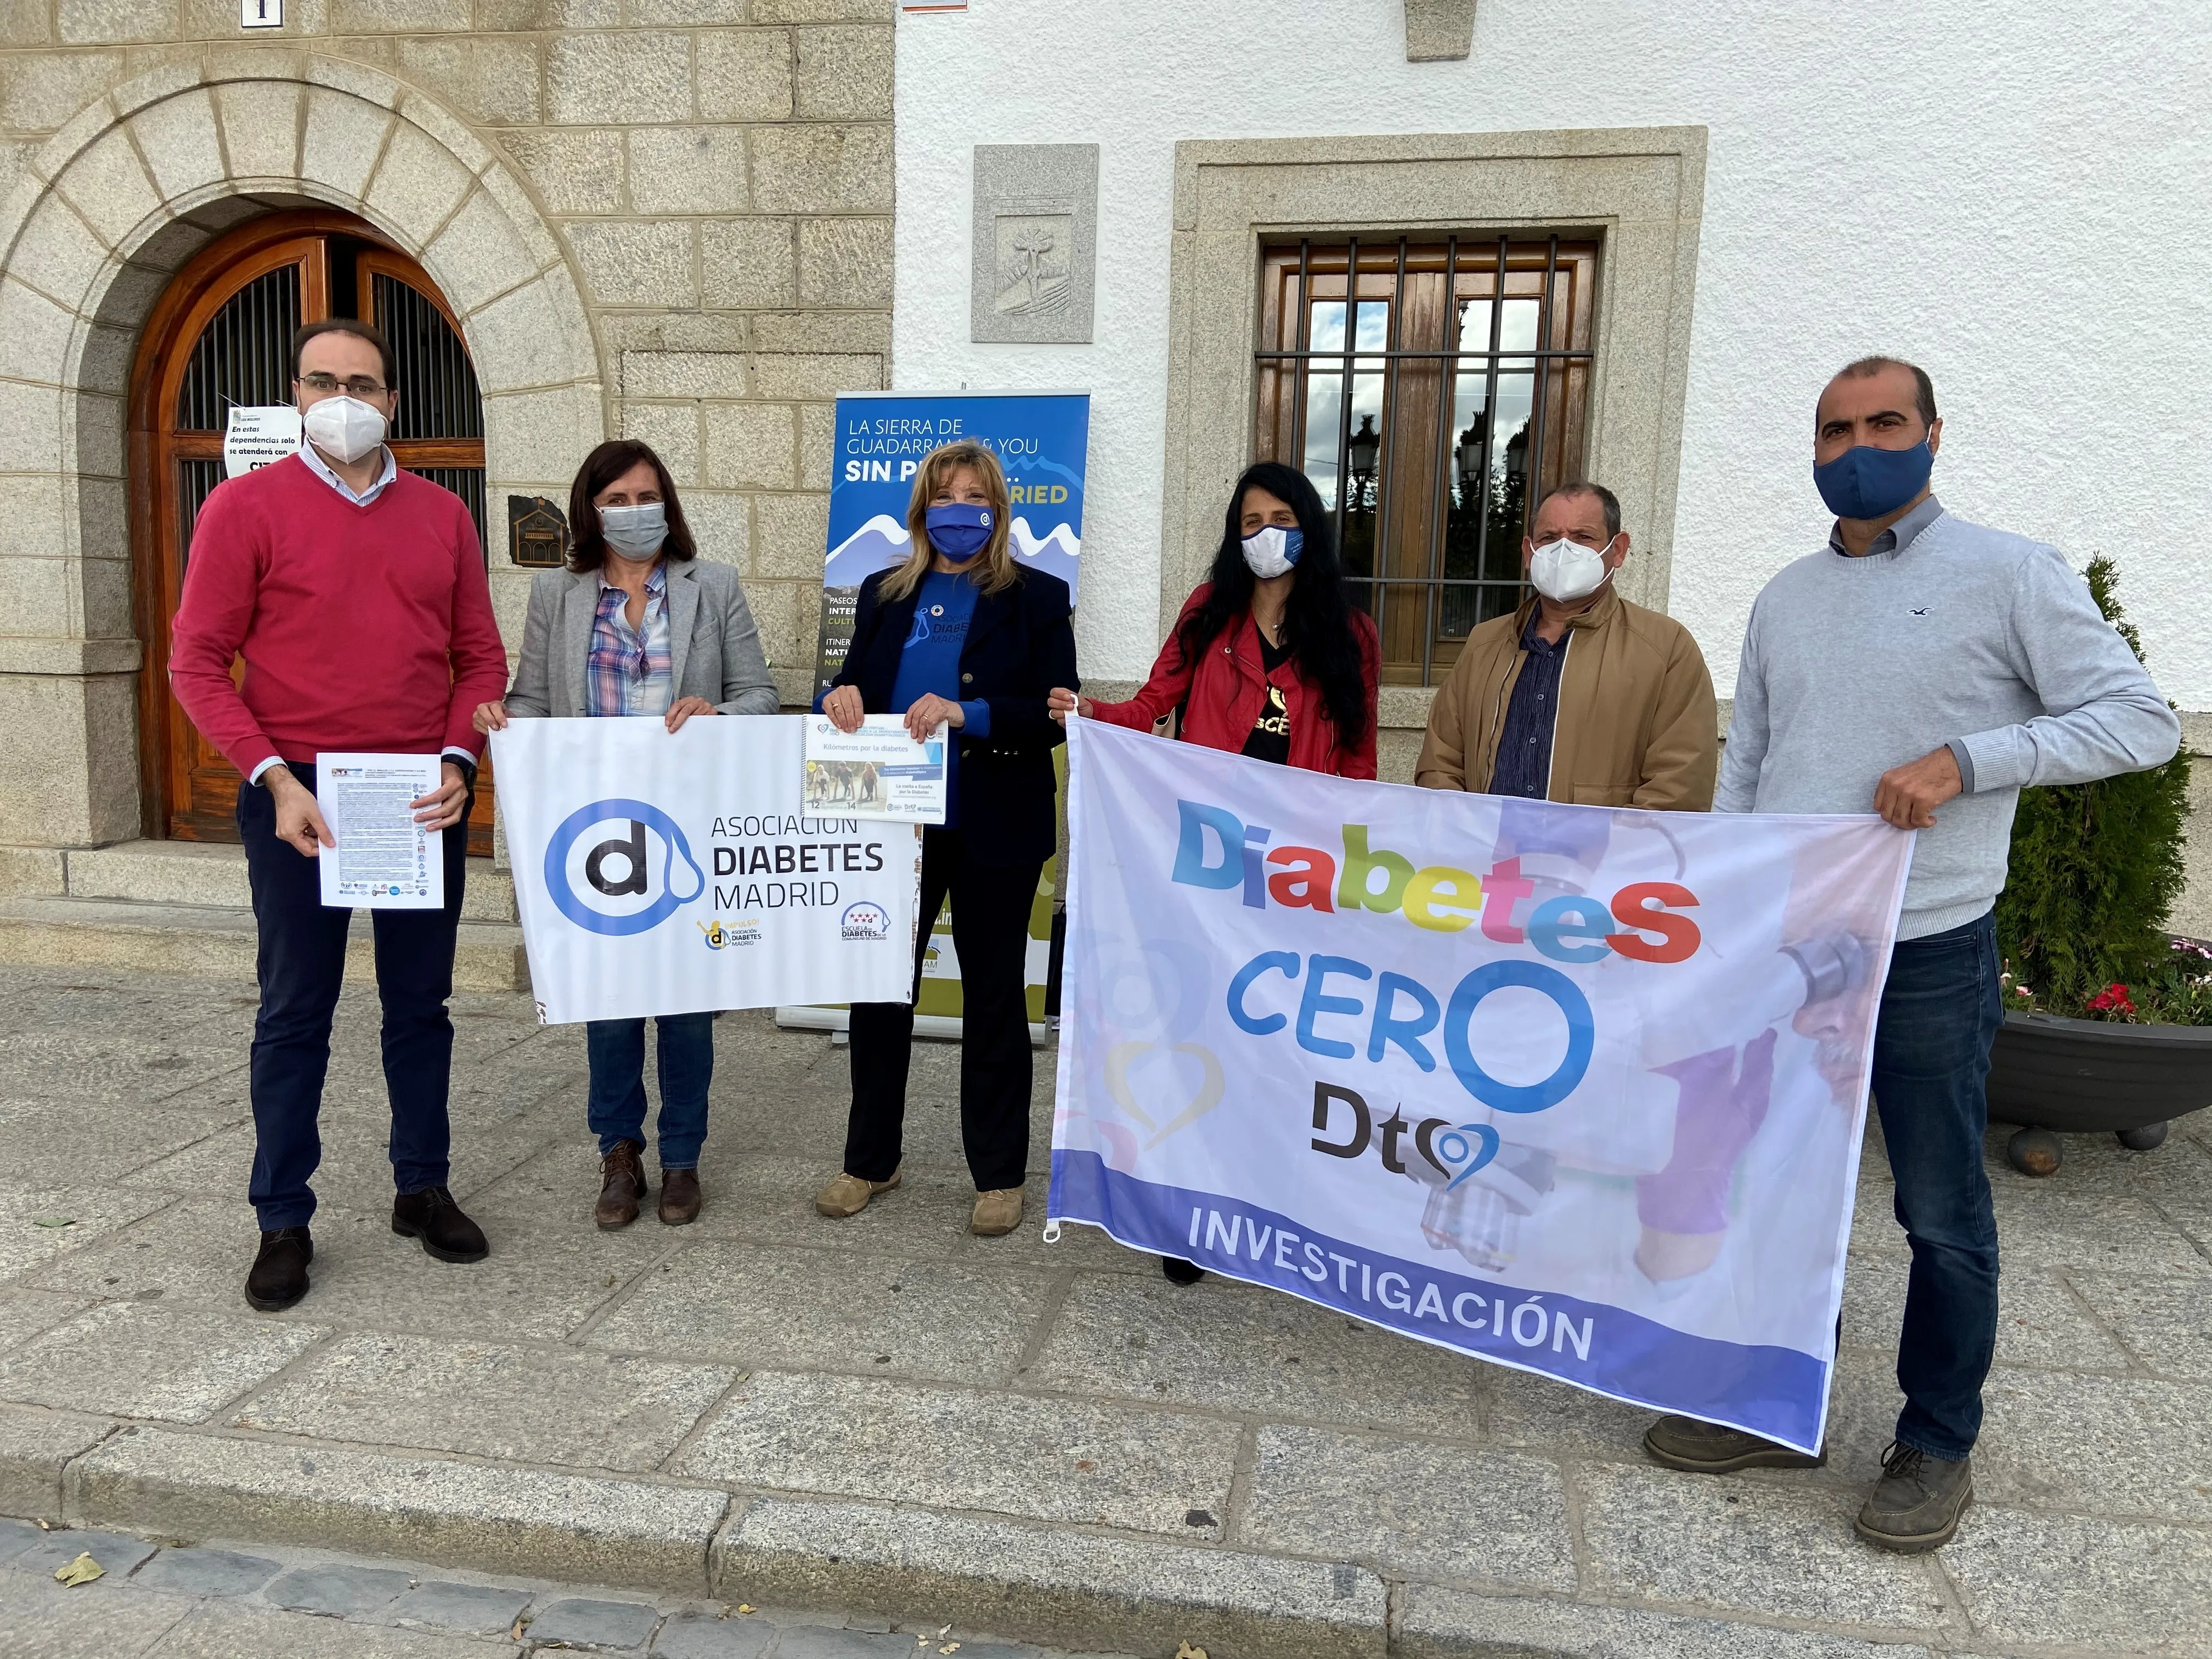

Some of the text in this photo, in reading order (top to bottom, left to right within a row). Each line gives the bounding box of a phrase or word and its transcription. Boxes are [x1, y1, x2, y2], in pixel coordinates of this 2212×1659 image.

[849, 419, 962, 435] LA SIERRA DE
[847, 438, 961, 454] GUADARRA
[998, 438, 1038, 454] YOU
[845, 460, 891, 482] SIN
[1009, 485, 1068, 504] RIED
[931, 634, 966, 644] MADRI
[933, 622, 969, 633] DIABE
[585, 819, 647, 896] d
[713, 843, 884, 876] DIABETES
[1172, 799, 1701, 964] Diabetes
[715, 881, 839, 911] MADRID
[1227, 950, 1595, 1114] CERO
[1188, 1206, 1594, 1361] INVESTIGACIÓN
